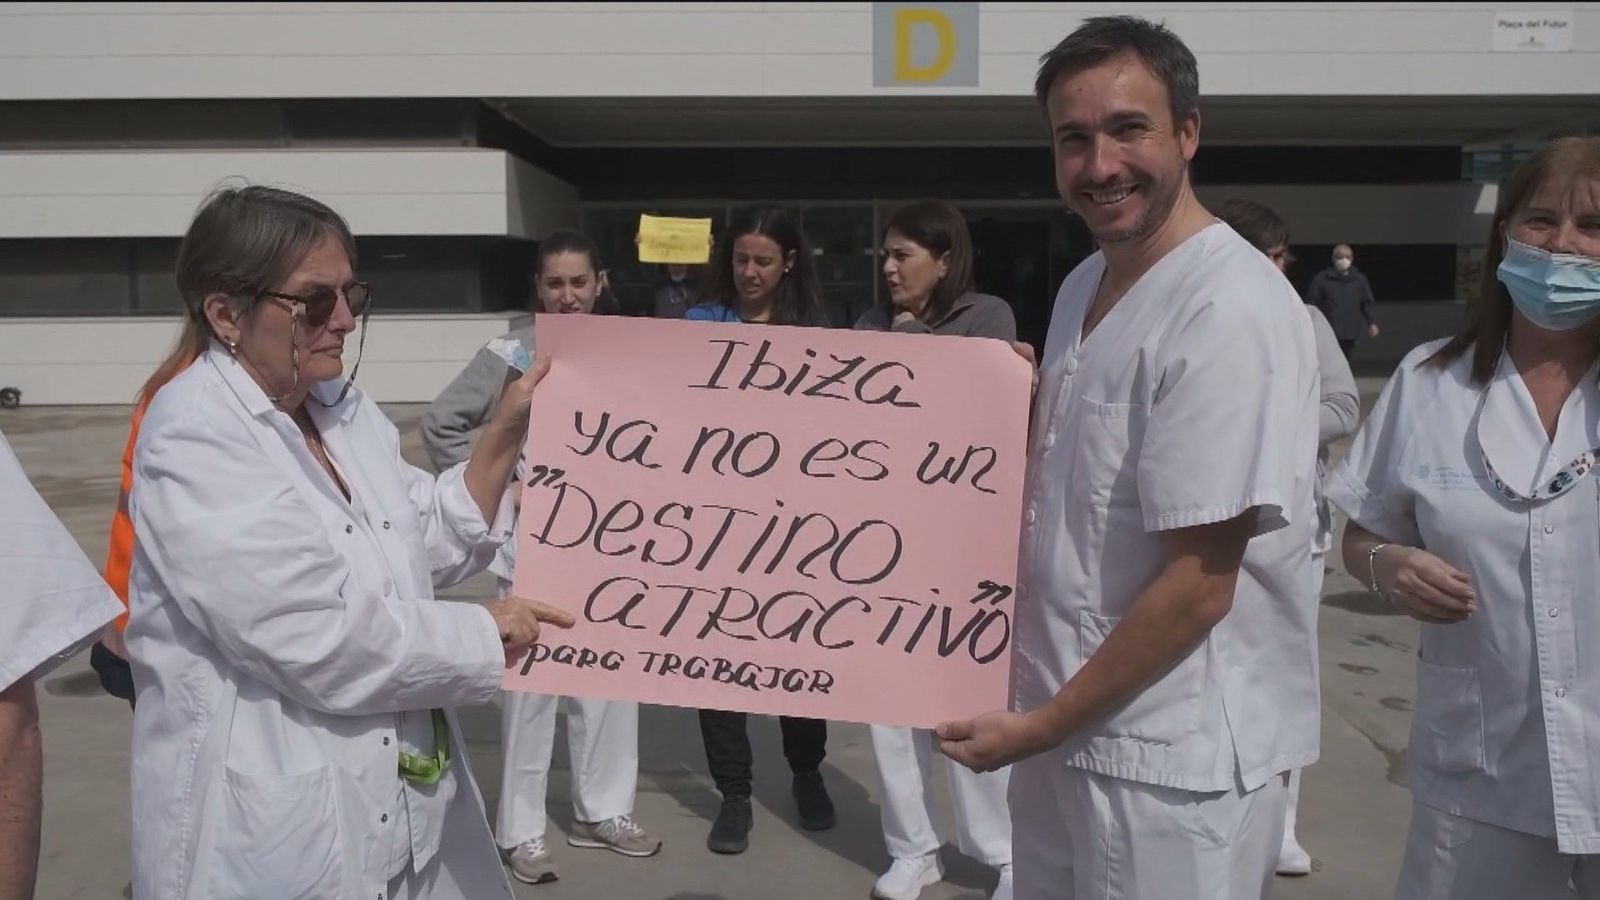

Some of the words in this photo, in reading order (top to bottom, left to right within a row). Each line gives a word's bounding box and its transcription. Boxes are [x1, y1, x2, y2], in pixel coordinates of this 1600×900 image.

[894, 8, 957, 82] D
[688, 339, 921, 408] Ibiza
[566, 411, 662, 469] ya
[682, 426, 782, 478] no
[799, 438, 890, 481] es
[915, 441, 998, 494] un
